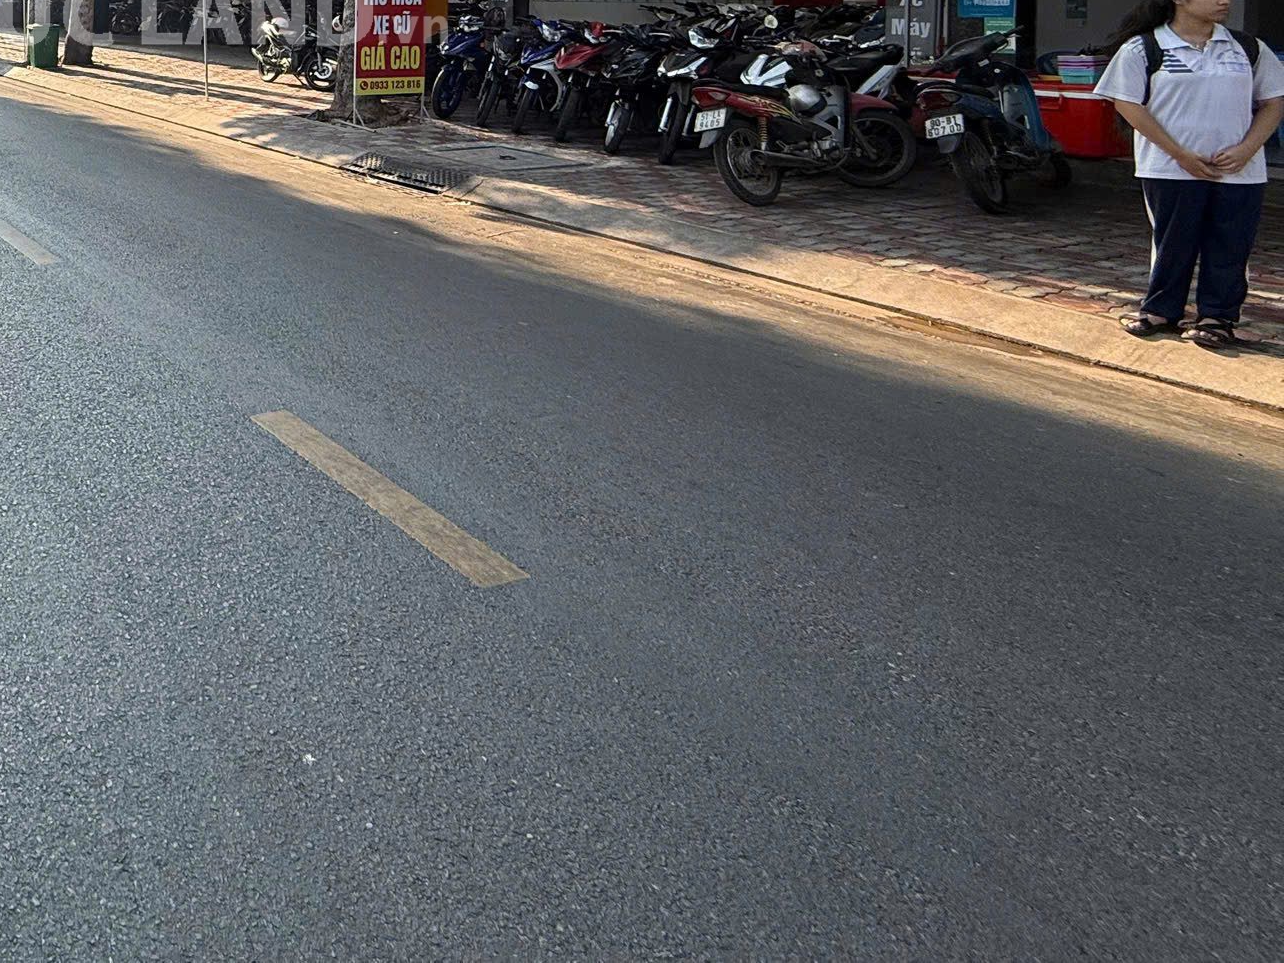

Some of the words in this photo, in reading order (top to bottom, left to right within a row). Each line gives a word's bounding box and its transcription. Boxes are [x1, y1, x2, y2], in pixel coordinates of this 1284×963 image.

[372, 14, 389, 35] XE
[393, 10, 411, 35] CŨ
[891, 17, 931, 38] Máy
[360, 40, 386, 71] GIÁ
[390, 45, 421, 70] CAO
[369, 81, 389, 90] 0933
[391, 80, 405, 89] 123
